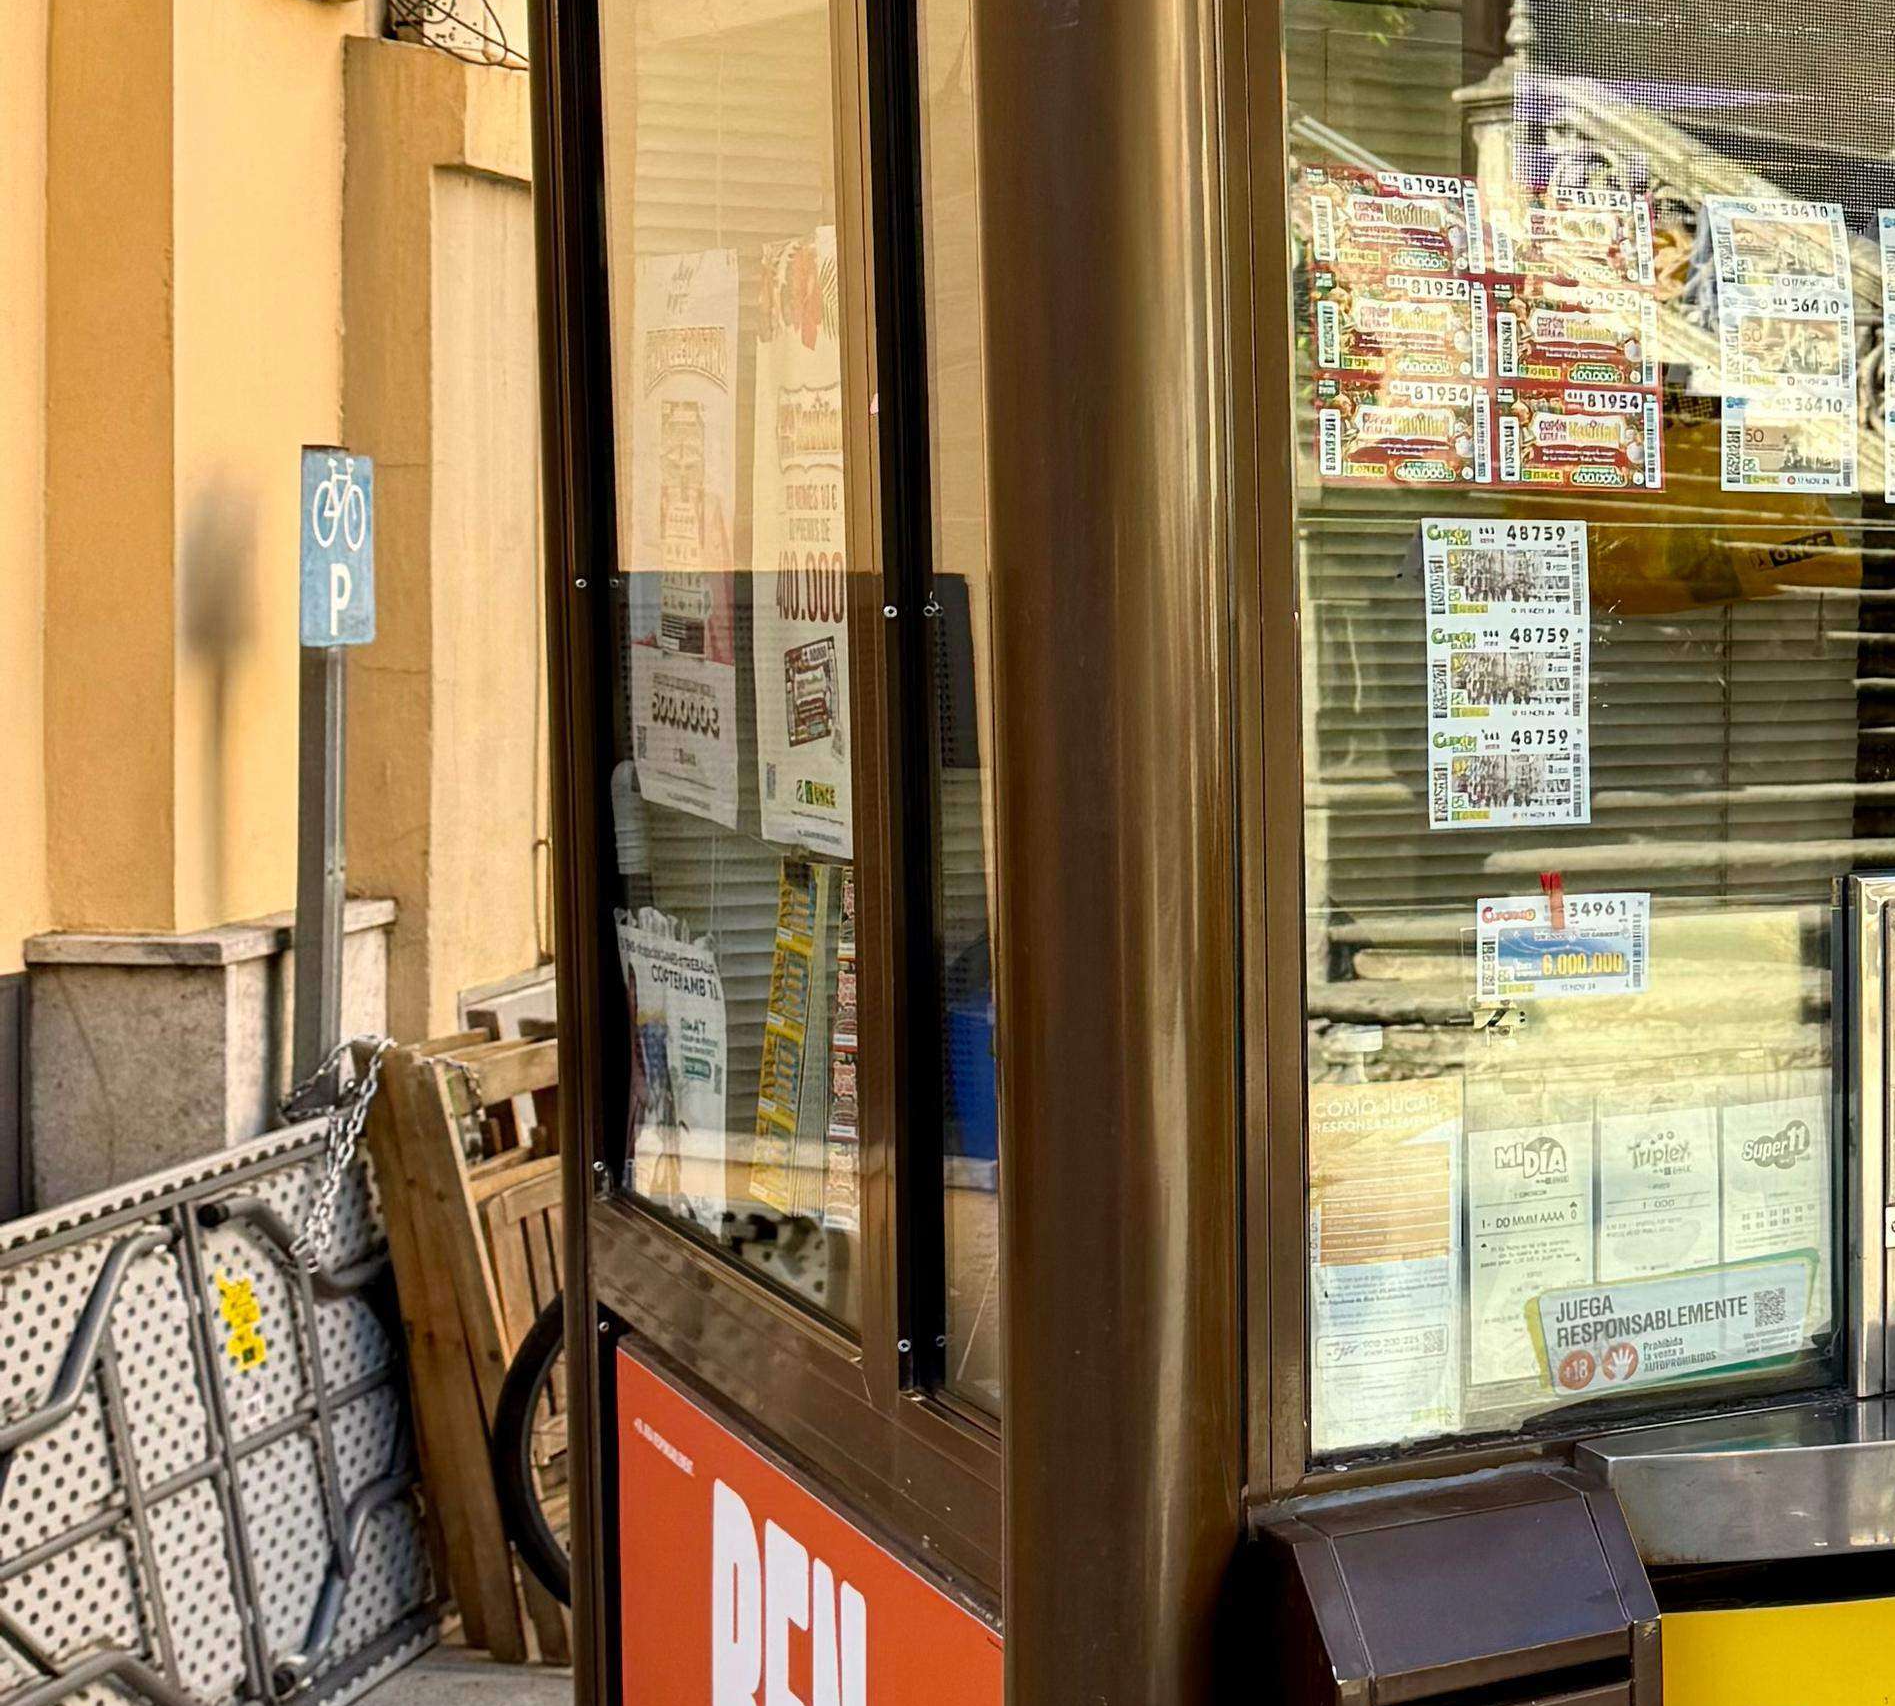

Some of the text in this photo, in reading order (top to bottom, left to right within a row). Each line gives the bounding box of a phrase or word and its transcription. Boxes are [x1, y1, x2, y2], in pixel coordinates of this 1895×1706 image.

[1414, 387, 1468, 401] 81954
[1588, 395, 1639, 409] 81954
[1796, 398, 1842, 413] 36410
[1746, 429, 1764, 443] 50
[1507, 525, 1565, 541] 48759
[330, 563, 352, 636] P
[1510, 627, 1569, 643] 48759
[1511, 729, 1568, 745] 48759
[1569, 900, 1626, 917] 34961
[1495, 1142, 1566, 1179] MI DÍA
[1556, 1295, 1613, 1323] JUEGA
[1557, 1296, 1748, 1348] RESPONSABLEMENTE
[1643, 1351, 1716, 1373] AUTOPROHIBIDOS
